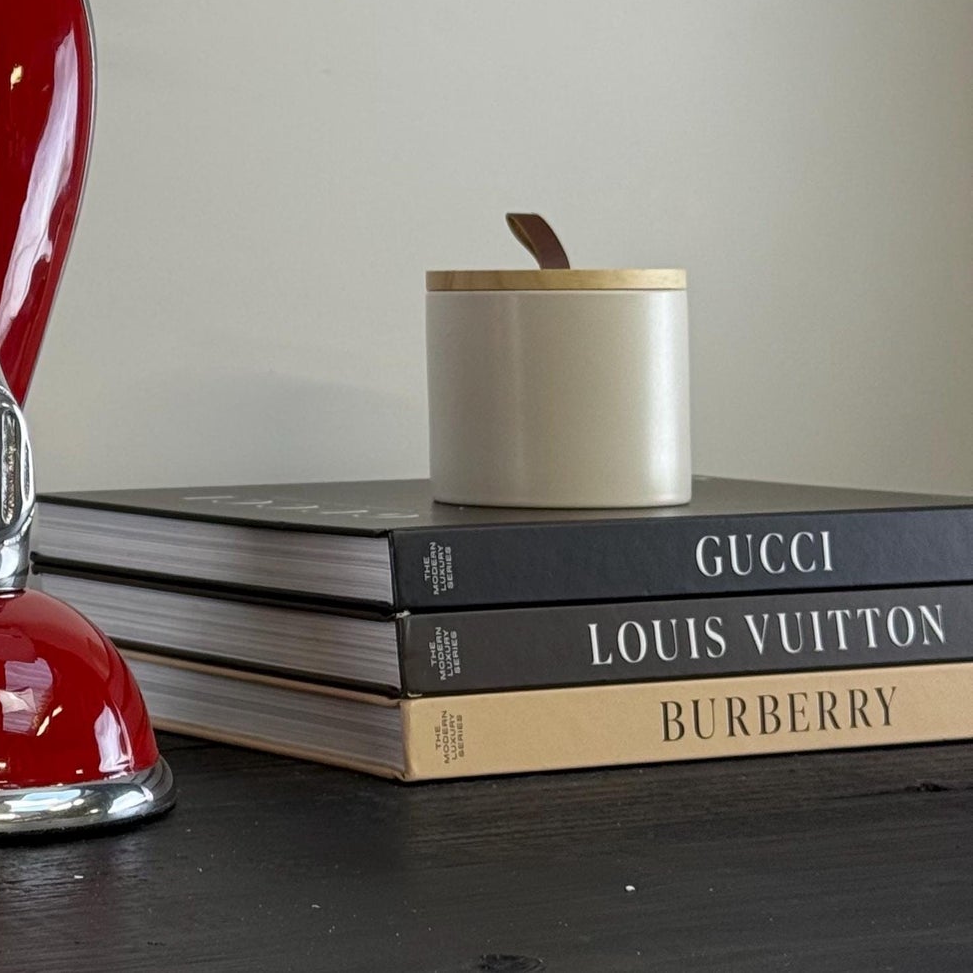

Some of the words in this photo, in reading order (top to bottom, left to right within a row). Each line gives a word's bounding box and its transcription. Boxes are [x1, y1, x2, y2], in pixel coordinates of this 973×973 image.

[423, 556, 431, 581] THE
[429, 541, 439, 595] MODERN
[437, 545, 447, 591] LUXURY
[445, 546, 454, 589] SERIES
[695, 531, 833, 577] GUCCI
[429, 641, 437, 667] THE
[435, 626, 447, 681] MODERN
[442, 629, 454, 677] LUXURY
[450, 630, 461, 674] SERIES
[587, 615, 727, 666] LOUIS
[743, 604, 947, 655] VUITTON
[441, 710, 450, 764] MODERN
[449, 713, 458, 761] LUXURY
[456, 714, 465, 758] SERIES
[660, 686, 898, 743] BURBERRY
